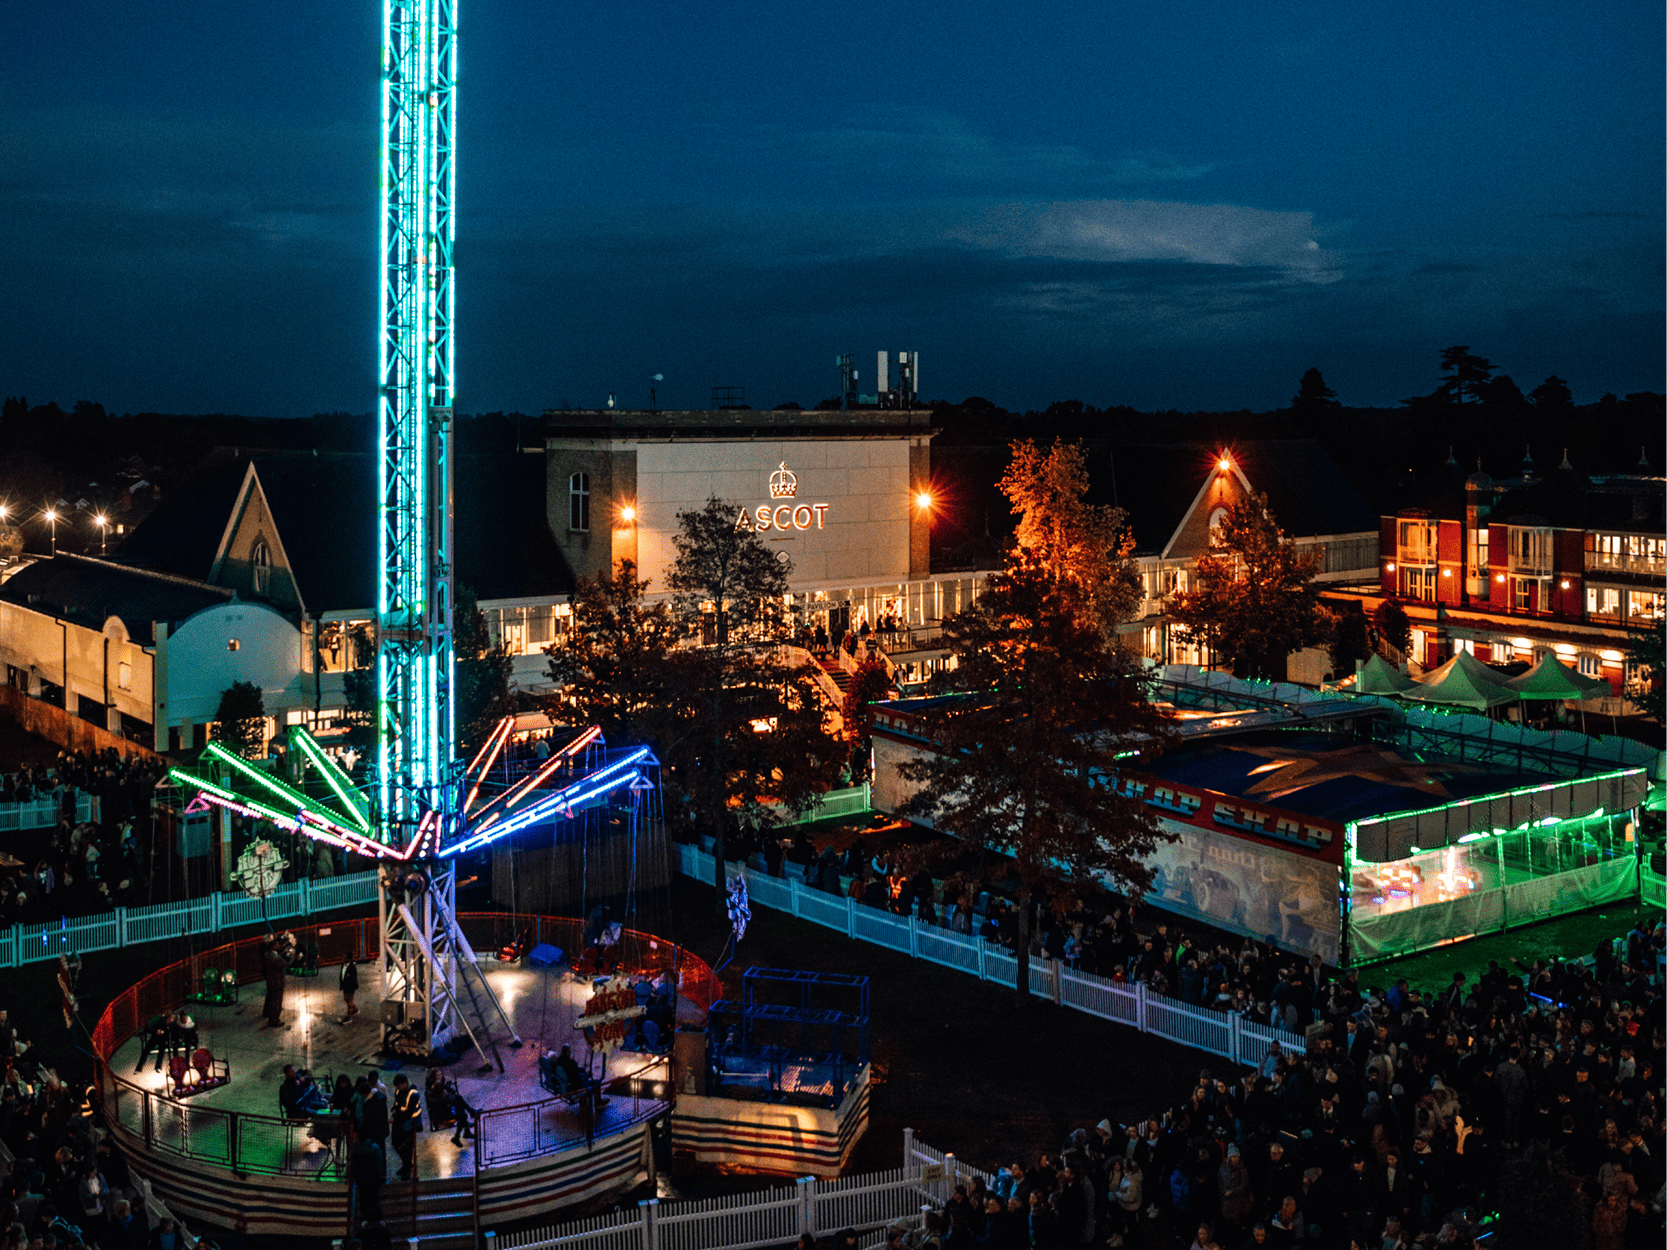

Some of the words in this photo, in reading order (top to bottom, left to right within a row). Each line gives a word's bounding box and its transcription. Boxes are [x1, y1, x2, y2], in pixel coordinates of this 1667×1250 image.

[733, 503, 830, 534] ASCOT
[807, 601, 836, 611] PAVILION
[1211, 801, 1333, 849] SHOP
